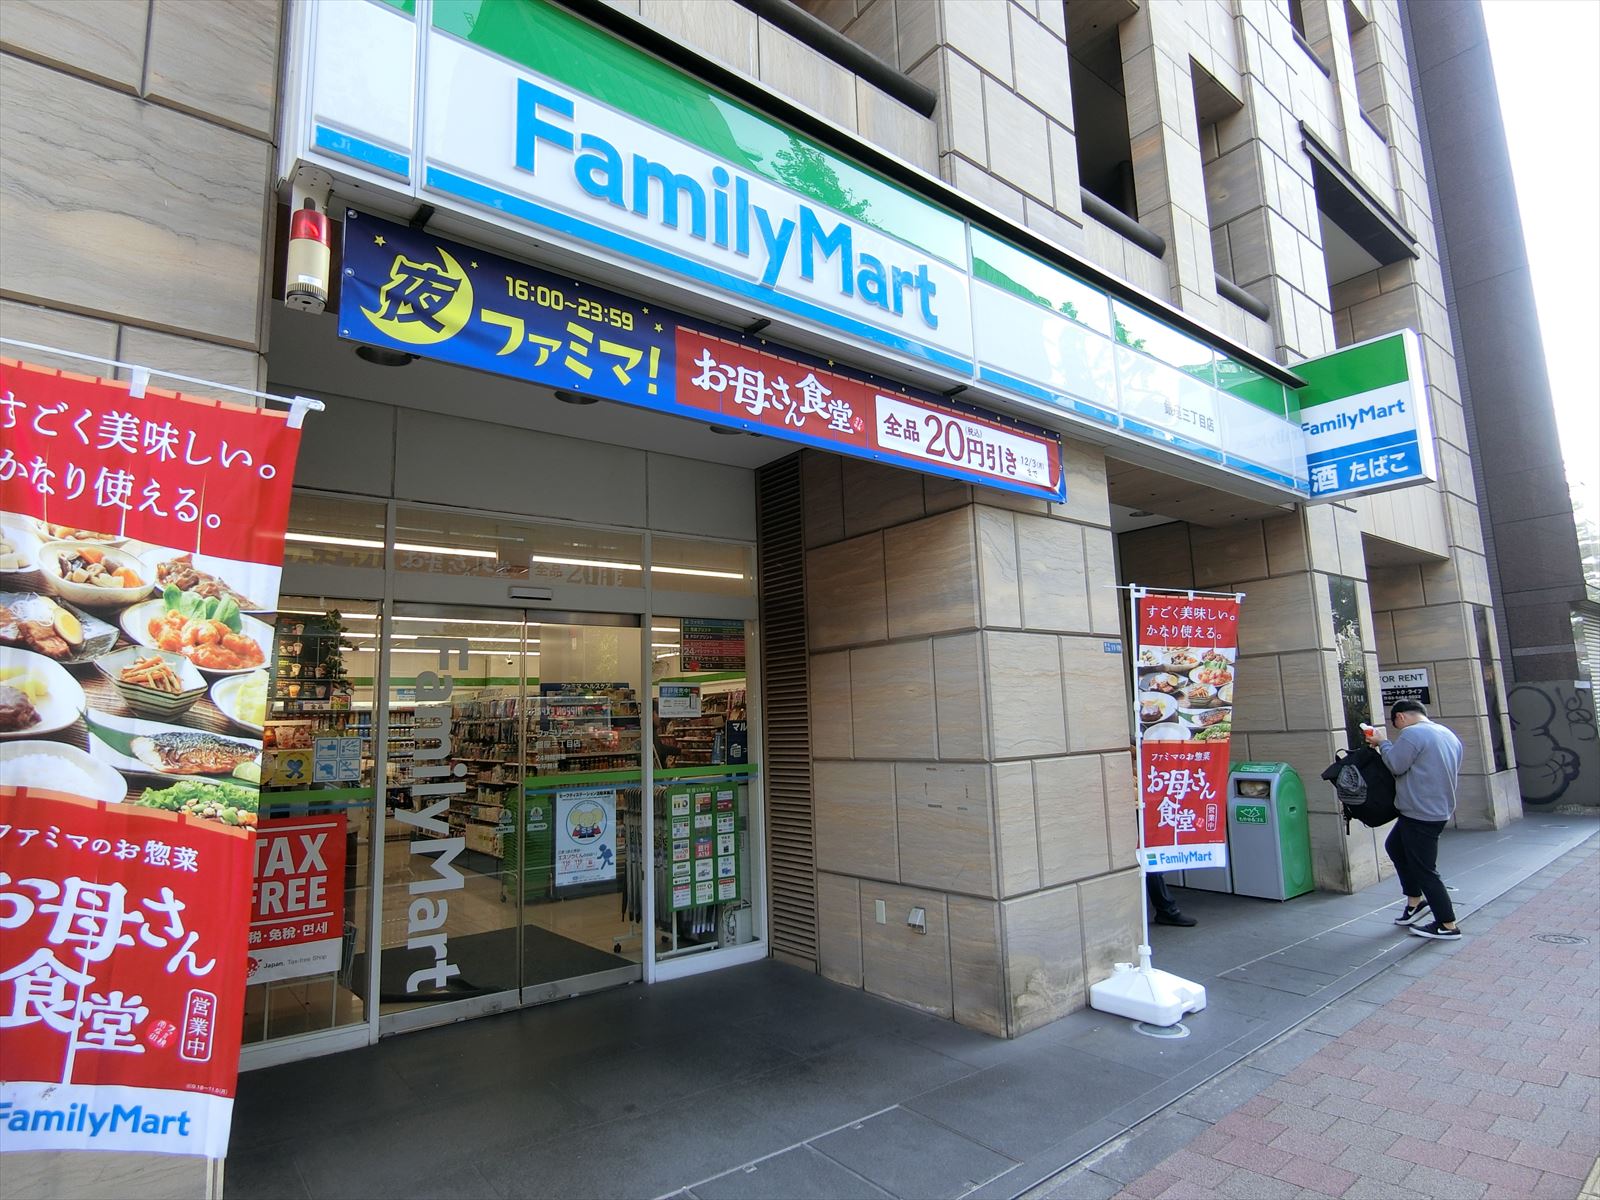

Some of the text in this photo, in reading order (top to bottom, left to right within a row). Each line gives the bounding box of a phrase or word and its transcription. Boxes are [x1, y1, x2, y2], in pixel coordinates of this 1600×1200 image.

[515, 77, 939, 331] FamilyMart
[505, 275, 634, 332] 16:00~23:59
[691, 348, 854, 434] お母さん食堂
[1163, 400, 1215, 432] 三丁目店
[1311, 452, 1409, 493] 酒 たばこ
[1146, 605, 1236, 621] すごく美味しい。
[1146, 624, 1222, 640] かなり使える。
[1379, 673, 1424, 683] OR RENT
[1147, 765, 1216, 800] お母さん
[394, 637, 470, 994] FamilyMart
[1157, 796, 1196, 832] 食堂
[0, 823, 199, 873] ファミマのお惣菜
[253, 833, 328, 878] TAX
[1160, 850, 1212, 865] FamilyMart
[0, 947, 149, 1054] 食堂
[186, 996, 213, 1057] 営業中
